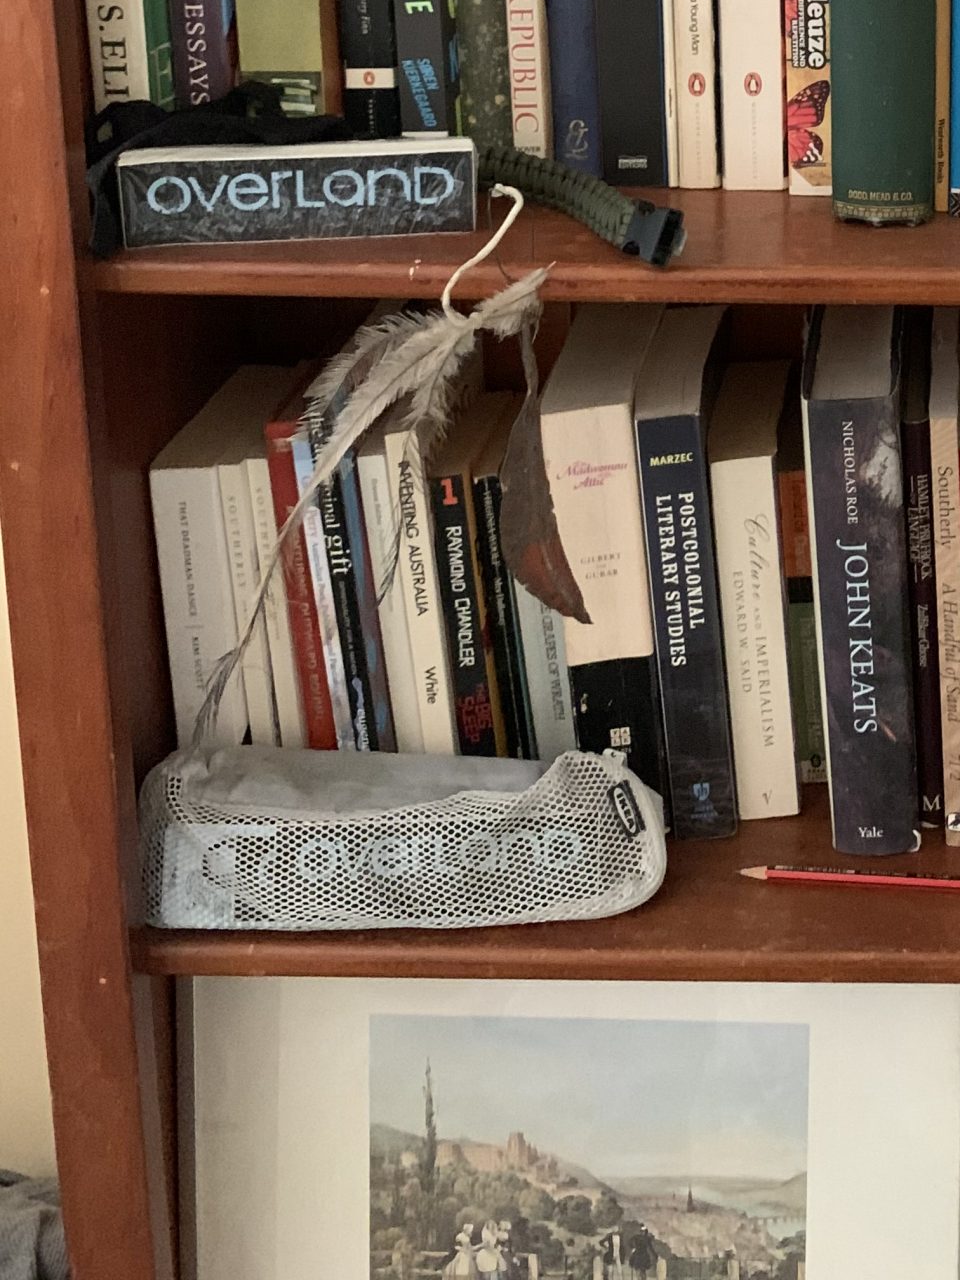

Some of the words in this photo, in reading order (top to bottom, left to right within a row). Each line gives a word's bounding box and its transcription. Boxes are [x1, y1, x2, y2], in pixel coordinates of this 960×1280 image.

[181, 1, 211, 105] ESSAYS
[649, 454, 695, 465] MARZEC
[840, 419, 857, 494] NICHOLAS
[654, 493, 680, 584] LITERARY
[844, 496, 860, 525] ROE
[327, 533, 350, 575] gift
[444, 525, 465, 592] RAYMOND
[678, 489, 707, 629] POSTCOLONIAL
[835, 536, 872, 628] JOHN
[453, 597, 476, 666] CHANDLER
[664, 588, 688, 666] STUDIES
[847, 636, 879, 734] KEATS
[858, 825, 884, 837] Yale
